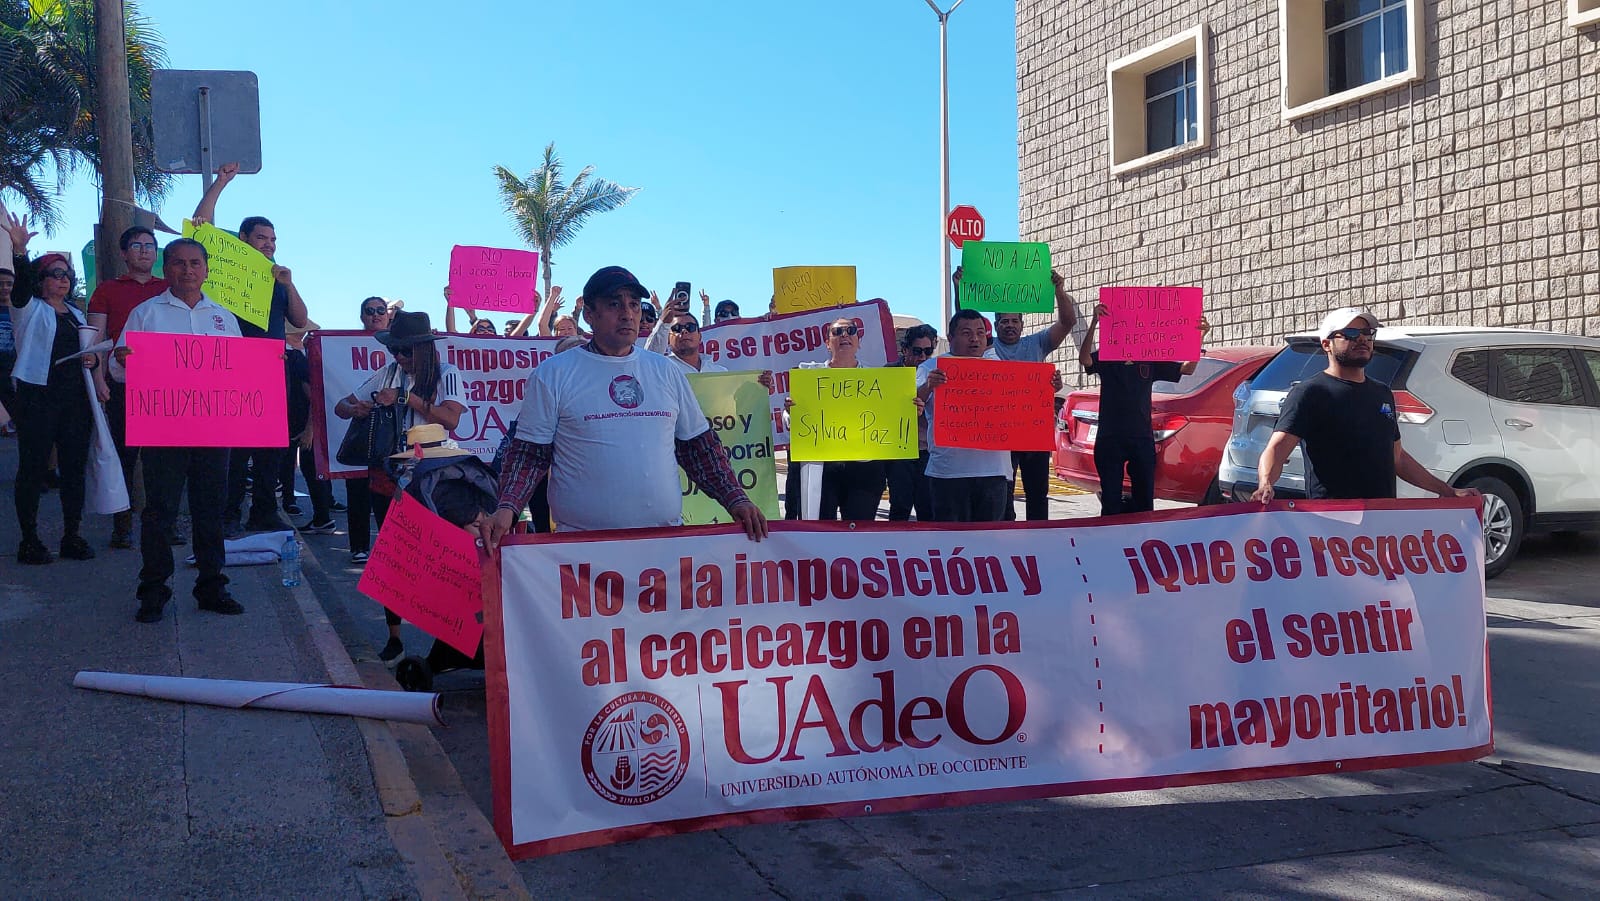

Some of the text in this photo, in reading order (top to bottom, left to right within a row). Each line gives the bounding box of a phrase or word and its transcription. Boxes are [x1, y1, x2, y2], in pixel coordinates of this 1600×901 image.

[949, 219, 982, 237] ALTO
[481, 249, 503, 264] NO
[983, 247, 1042, 270] NO A LA
[469, 268, 497, 277] acoso
[494, 281, 503, 291] la
[963, 282, 1042, 304] IMPOSICION
[469, 293, 520, 307] UAdeO
[1118, 289, 1181, 311] JUSTICIA
[725, 335, 758, 360] se
[1125, 332, 1166, 345] RECTOR
[174, 338, 232, 370] NO AL
[352, 347, 386, 371] No
[946, 364, 1041, 382] Queremos un
[816, 377, 883, 401] FUERA
[944, 387, 992, 399] proceso
[130, 389, 264, 418] INFLUYENTISMO
[739, 414, 752, 433] y
[798, 409, 847, 447] Sylvia
[1123, 530, 1468, 595] ¡Que se respete
[559, 547, 1042, 619] No a la imposición y
[1225, 600, 1414, 664] el sentir
[581, 605, 1021, 687] al cacicazgo en la
[584, 693, 686, 745] POR LA CULTURA A LA LIBERTAD
[712, 664, 1027, 765] UAdeO
[1188, 674, 1467, 750] mayoritario!
[720, 755, 1028, 798] UNIVERSIDAD AUTÓNOMA DE OCCIDENTE
[618, 793, 657, 804] SINALOA
